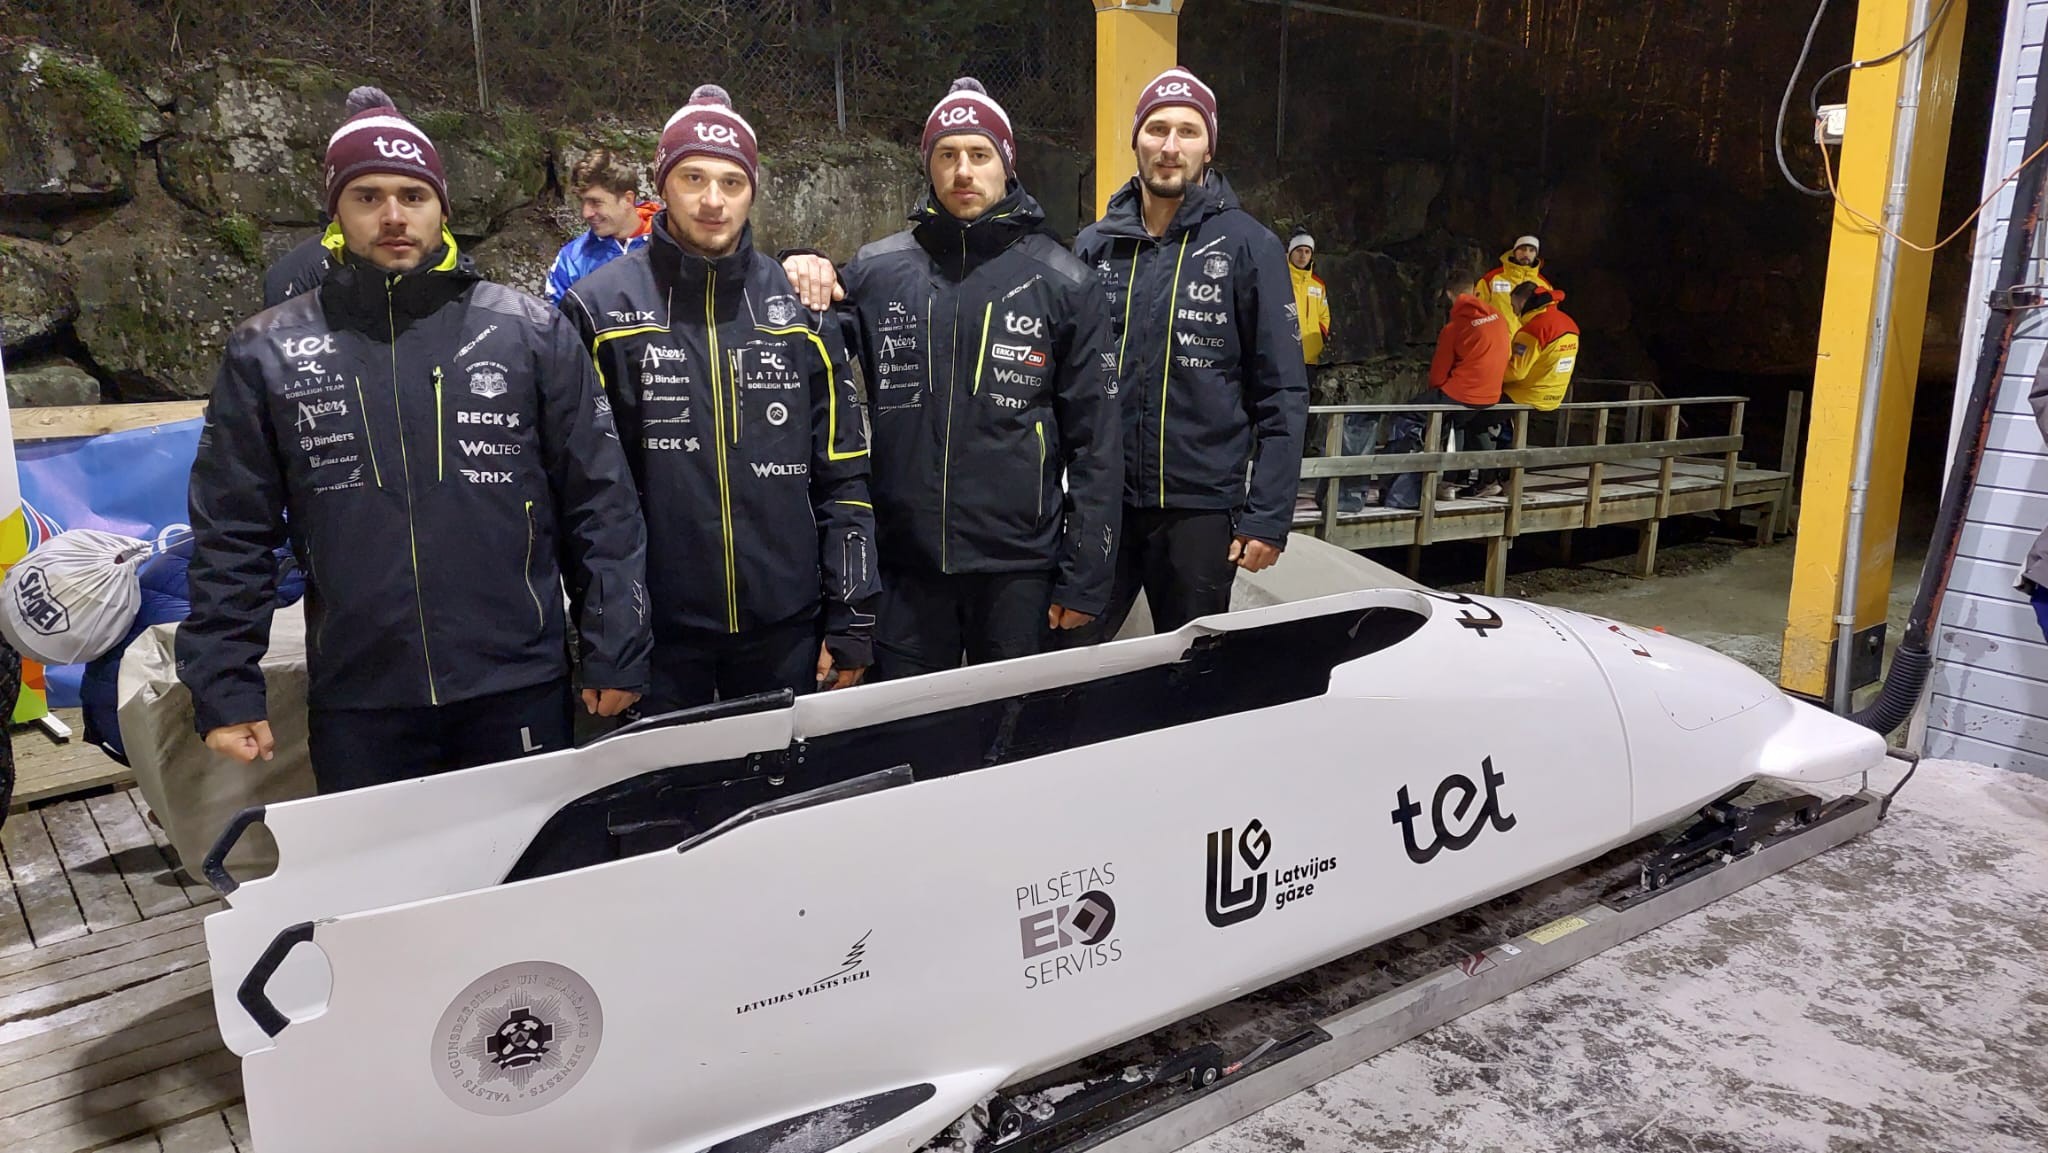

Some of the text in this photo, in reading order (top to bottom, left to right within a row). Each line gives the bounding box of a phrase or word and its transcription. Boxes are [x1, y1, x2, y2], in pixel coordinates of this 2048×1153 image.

[1155, 82, 1193, 98] tet
[938, 106, 979, 127] tet
[693, 122, 739, 148] tet
[373, 136, 427, 165] tet
[1187, 281, 1222, 303] tet
[878, 315, 917, 325] LATVIA
[1004, 312, 1042, 338] tet
[1178, 309, 1212, 323] RECK
[283, 334, 337, 357] tet
[1176, 332, 1224, 348] WOLTEC
[747, 371, 799, 381] LATVIA
[891, 363, 920, 373] Binders
[993, 367, 1042, 387] WOLTEC
[284, 373, 344, 391] LATVIA
[325, 384, 345, 393] TEAM
[654, 375, 690, 384] Binders
[457, 411, 504, 425] RECK
[313, 432, 356, 446] Binders
[458, 440, 521, 456] WOLTEC
[750, 462, 807, 478] WOLTEC
[19, 572, 62, 631] SHOEI
[1391, 755, 1517, 864] tet
[1275, 855, 1337, 888] Latvijas
[1016, 862, 1116, 910] PILSĒTAS
[1275, 882, 1315, 910] gāze
[1023, 938, 1123, 989] SERVISS
[736, 991, 794, 1015] LATVIJAS
[797, 979, 839, 997] VALSTS
[462, 1078, 511, 1103] VALSTS
[517, 974, 539, 986] UN
